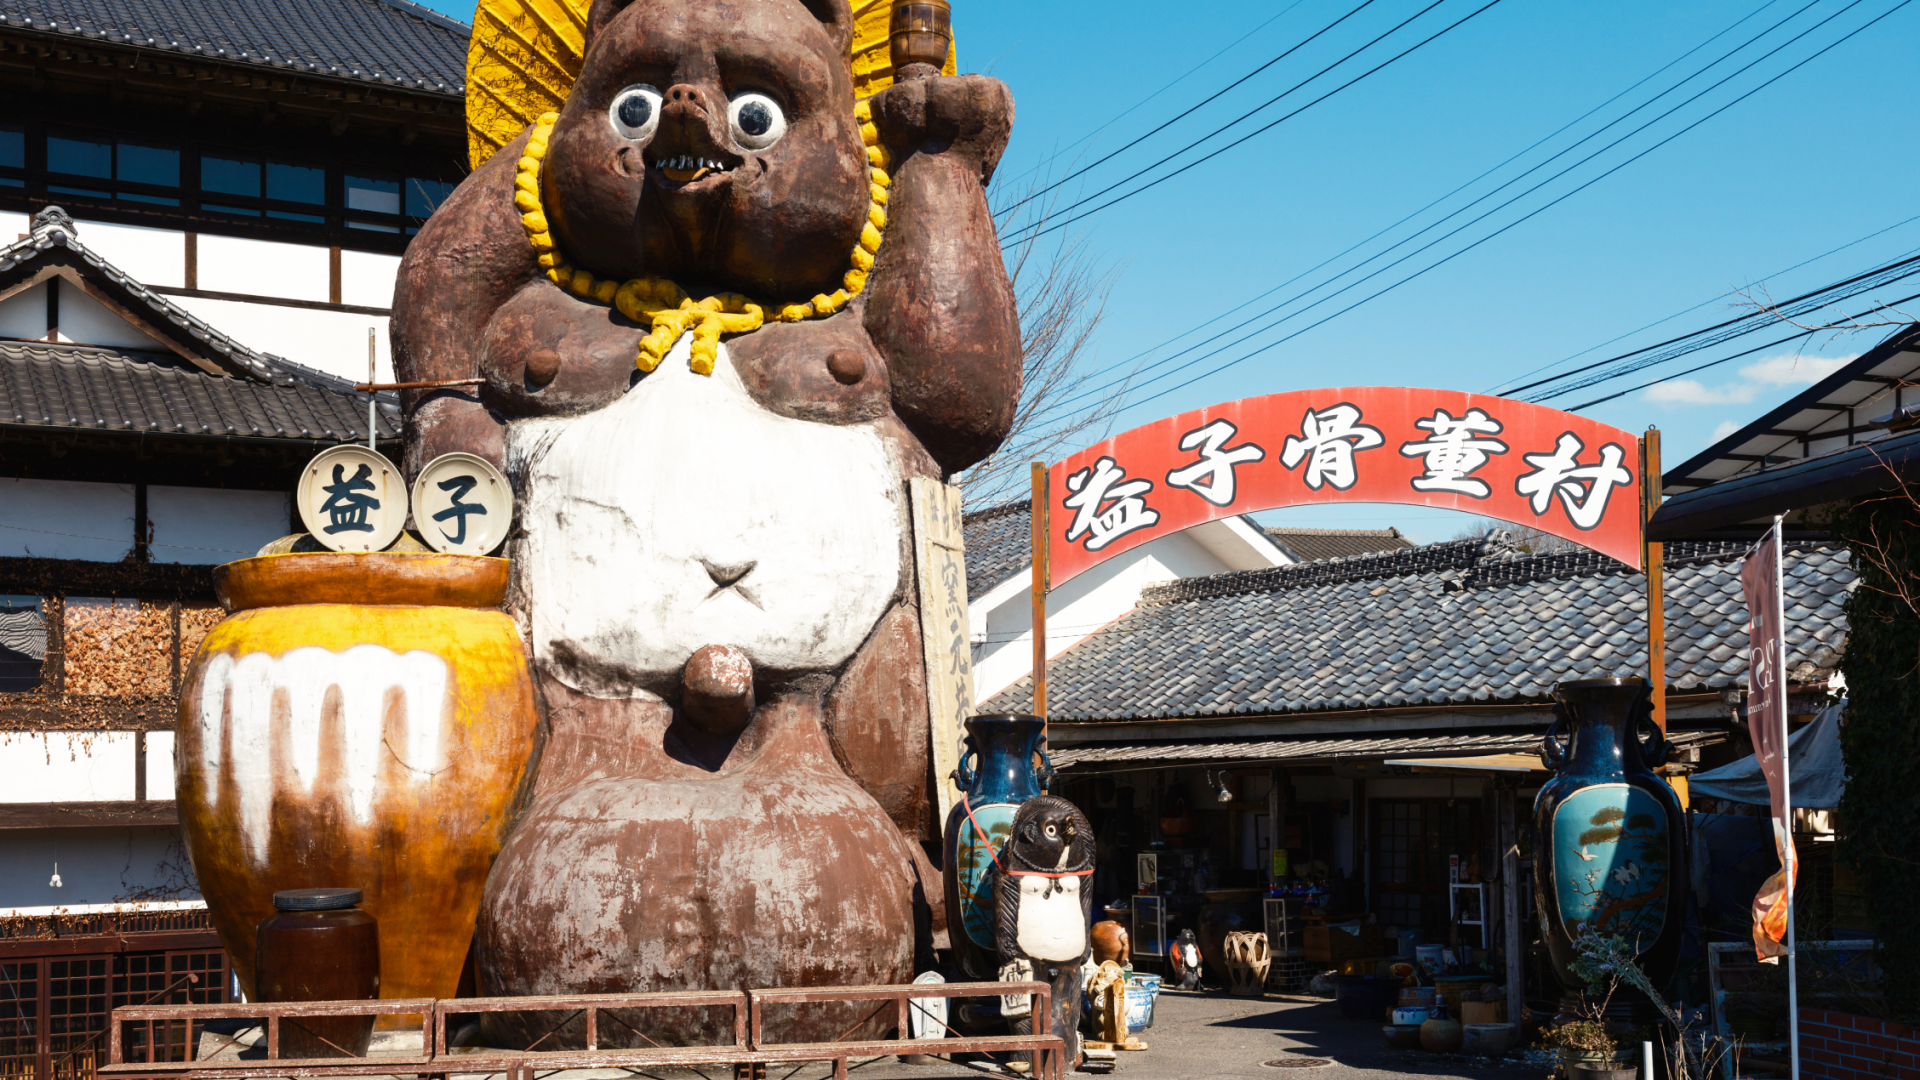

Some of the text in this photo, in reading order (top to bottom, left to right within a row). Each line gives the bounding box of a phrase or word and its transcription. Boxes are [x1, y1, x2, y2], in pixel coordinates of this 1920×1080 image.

[319, 463, 487, 545] 益 子
[1064, 402, 1633, 552] 益子骨董村
